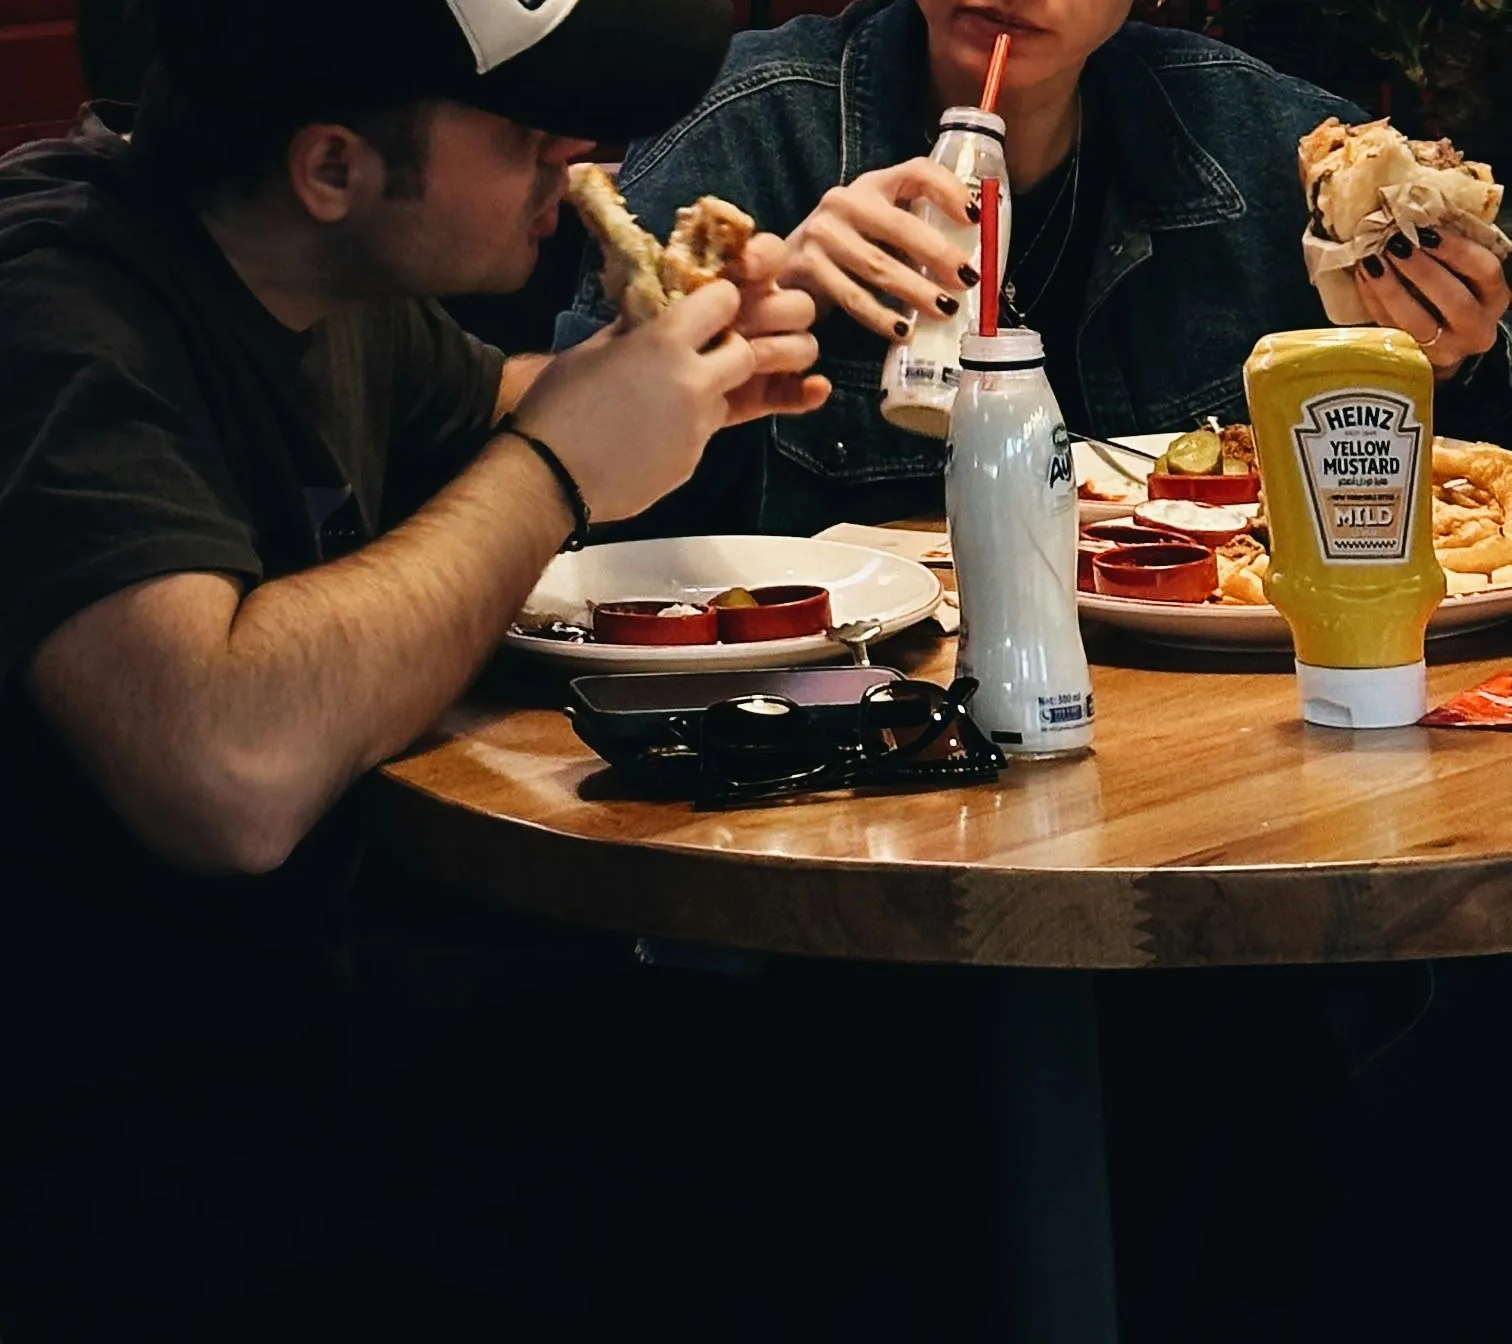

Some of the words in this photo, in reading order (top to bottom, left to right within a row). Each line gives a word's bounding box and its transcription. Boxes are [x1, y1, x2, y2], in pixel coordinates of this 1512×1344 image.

[1325, 406, 1395, 431] HEINZ
[1330, 440, 1391, 457] YELLOW
[1323, 458, 1400, 476] MUSTARD
[1334, 507, 1394, 528] MILD
